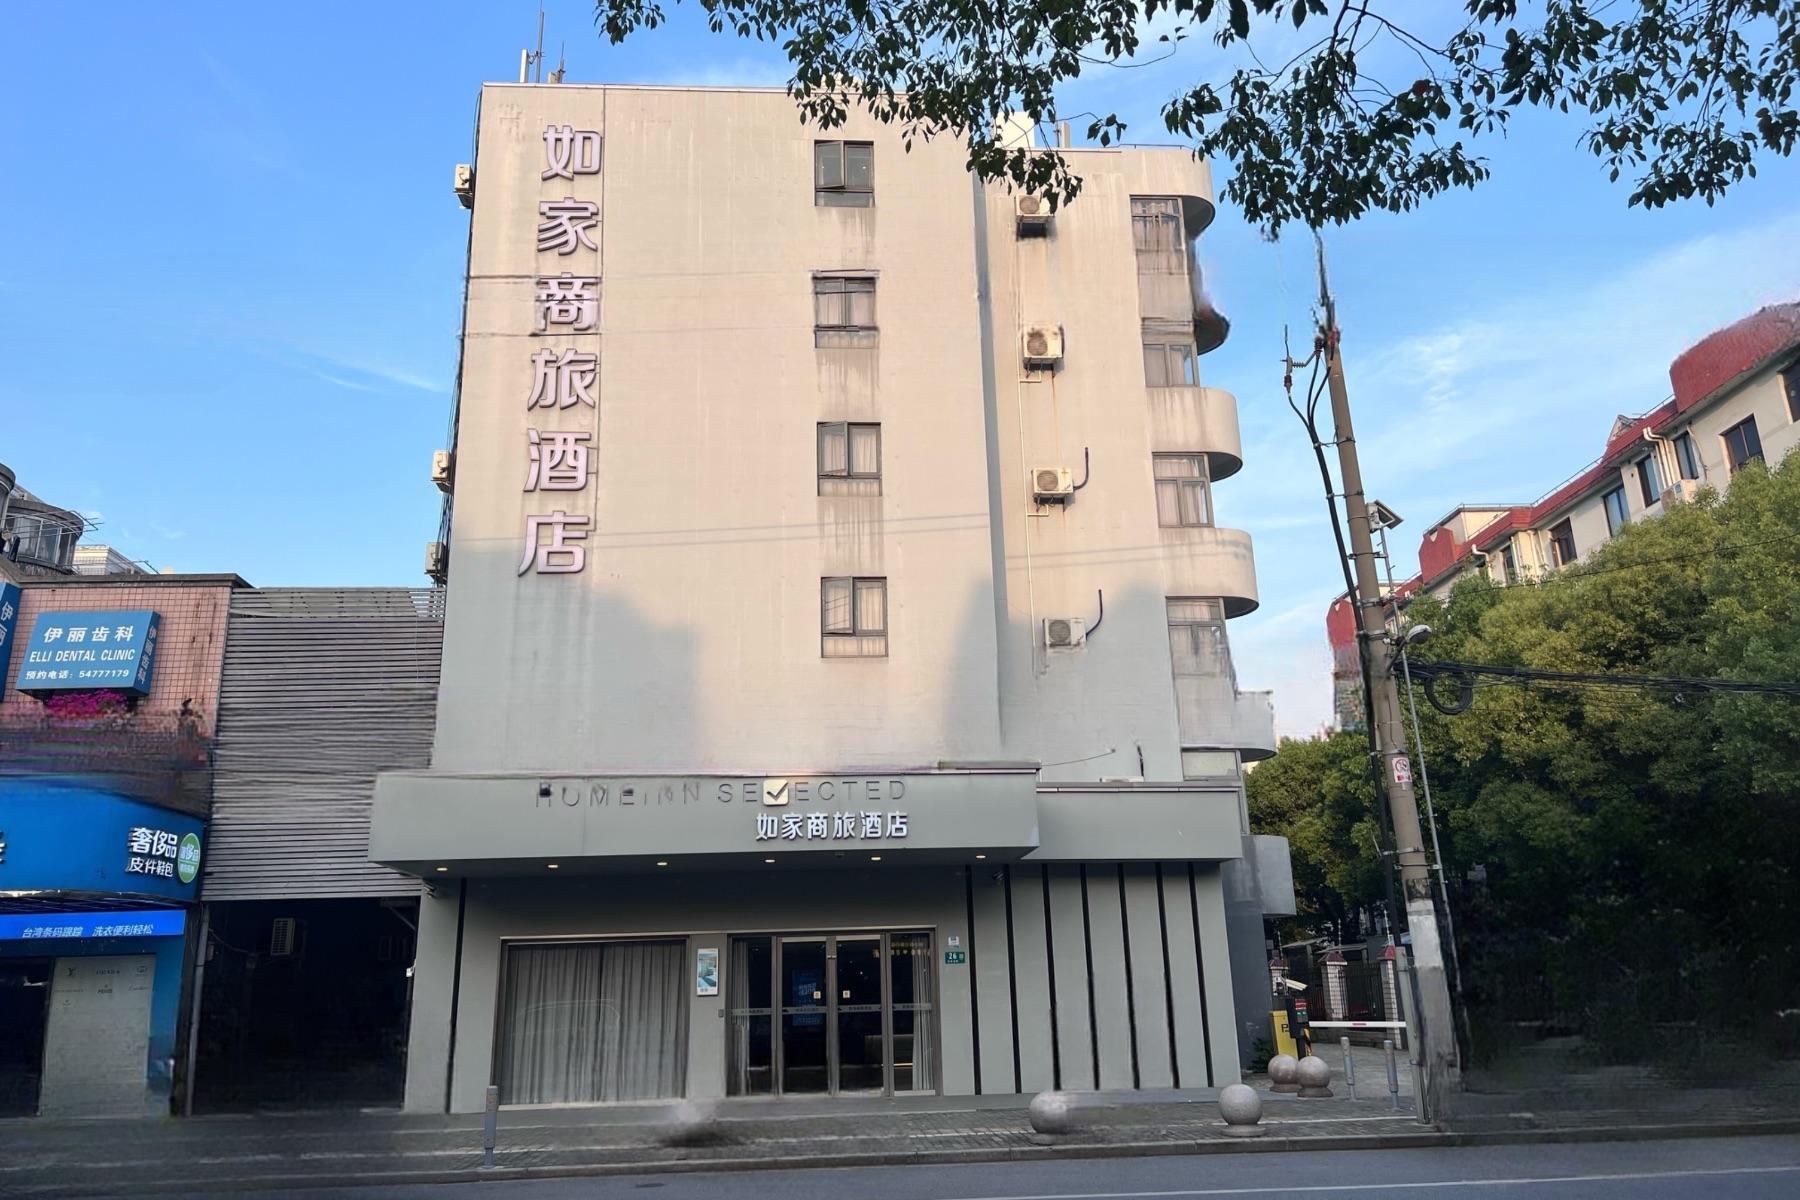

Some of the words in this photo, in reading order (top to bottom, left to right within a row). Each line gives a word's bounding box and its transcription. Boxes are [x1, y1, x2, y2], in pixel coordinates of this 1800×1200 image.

[517, 124, 603, 578] 如家商旅酒店
[43, 625, 134, 643] 伊丽齿科
[29, 651, 52, 663] ELLI
[55, 650, 96, 662] DENTAL
[101, 649, 136, 661] CLINIC
[79, 669, 130, 678] 54777179
[718, 779, 906, 805] SEECTED
[755, 811, 908, 840] 如家商旅酒店
[129, 827, 178, 858] 奢侈品
[128, 857, 174, 877] 皮件鞋包
